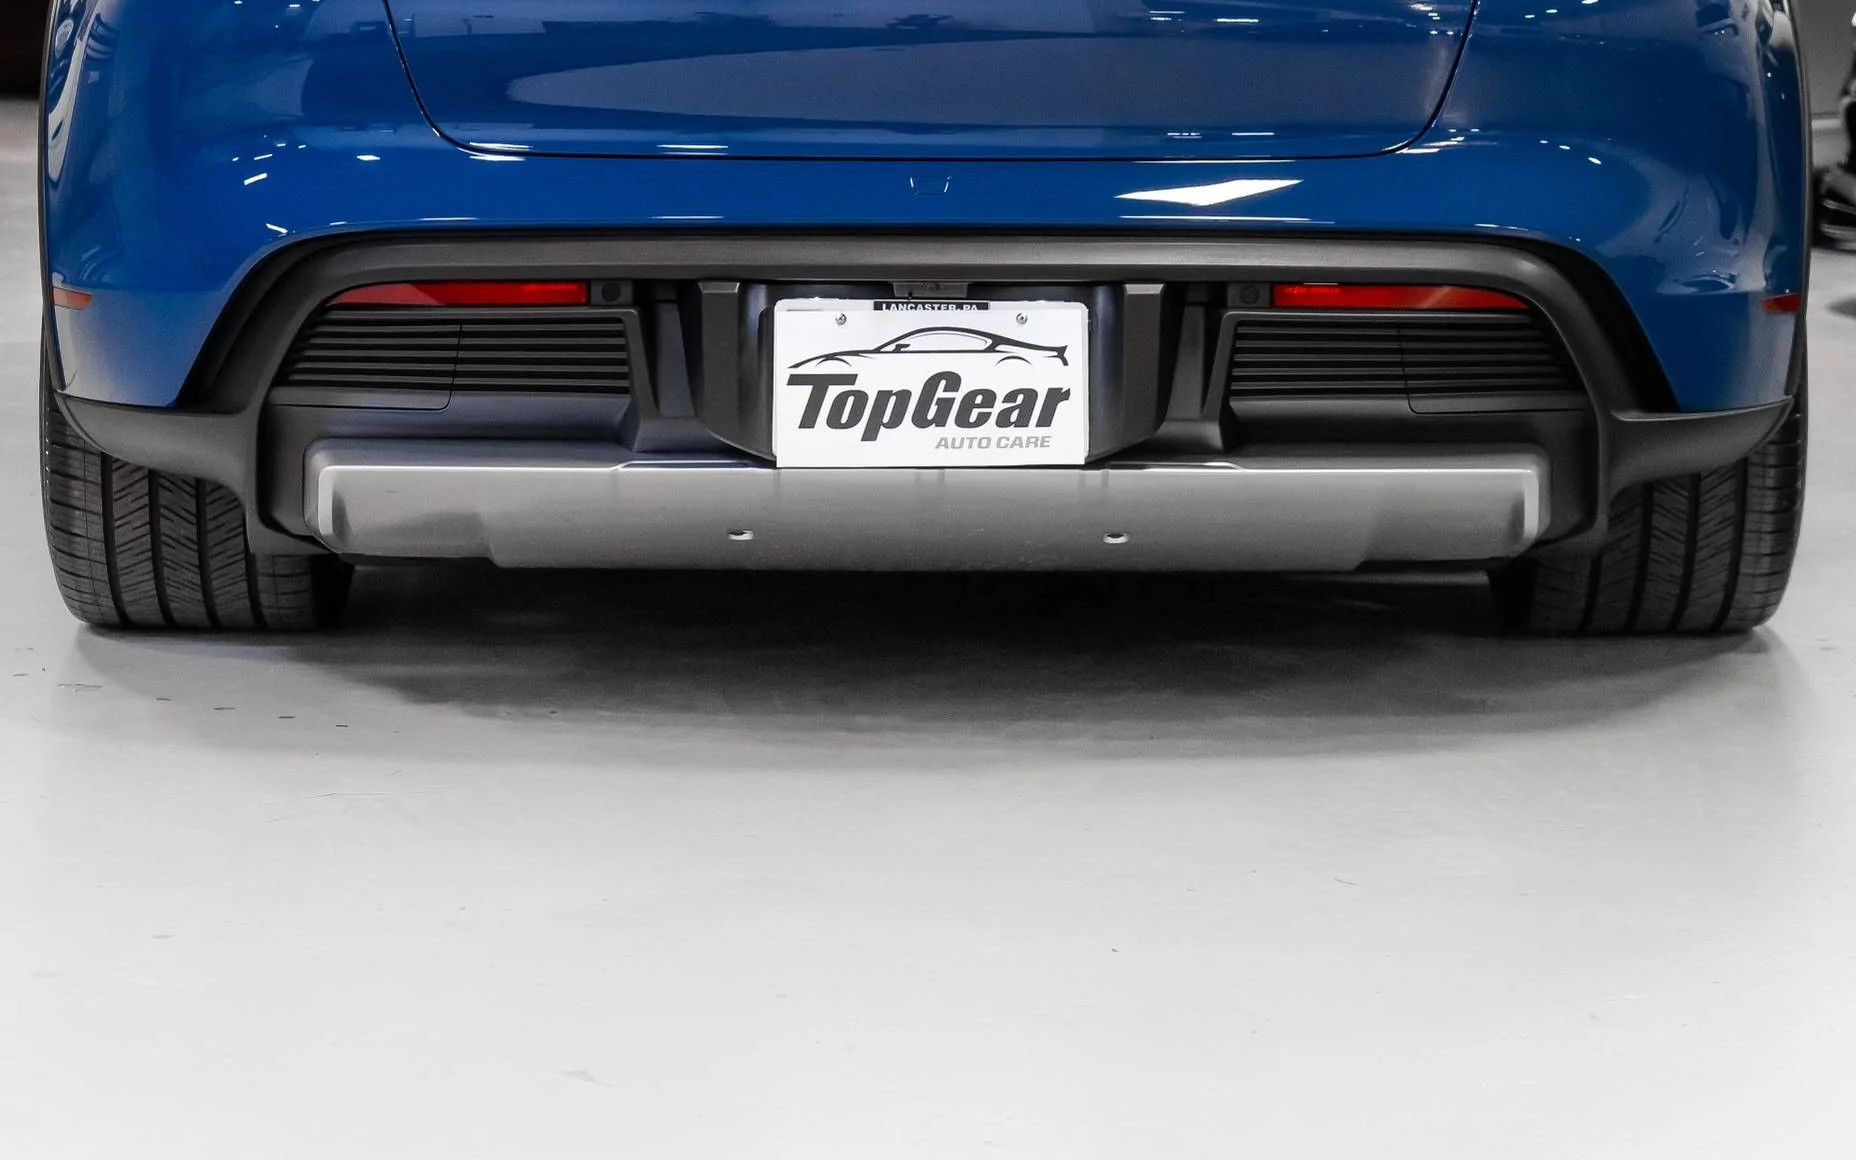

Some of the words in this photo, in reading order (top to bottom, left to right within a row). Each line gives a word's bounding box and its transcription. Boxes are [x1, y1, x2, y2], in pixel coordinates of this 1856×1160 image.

[962, 303, 978, 311] PA
[786, 370, 1071, 442] TopGear
[935, 436, 992, 449] AUTO
[996, 435, 1052, 449] CARE
